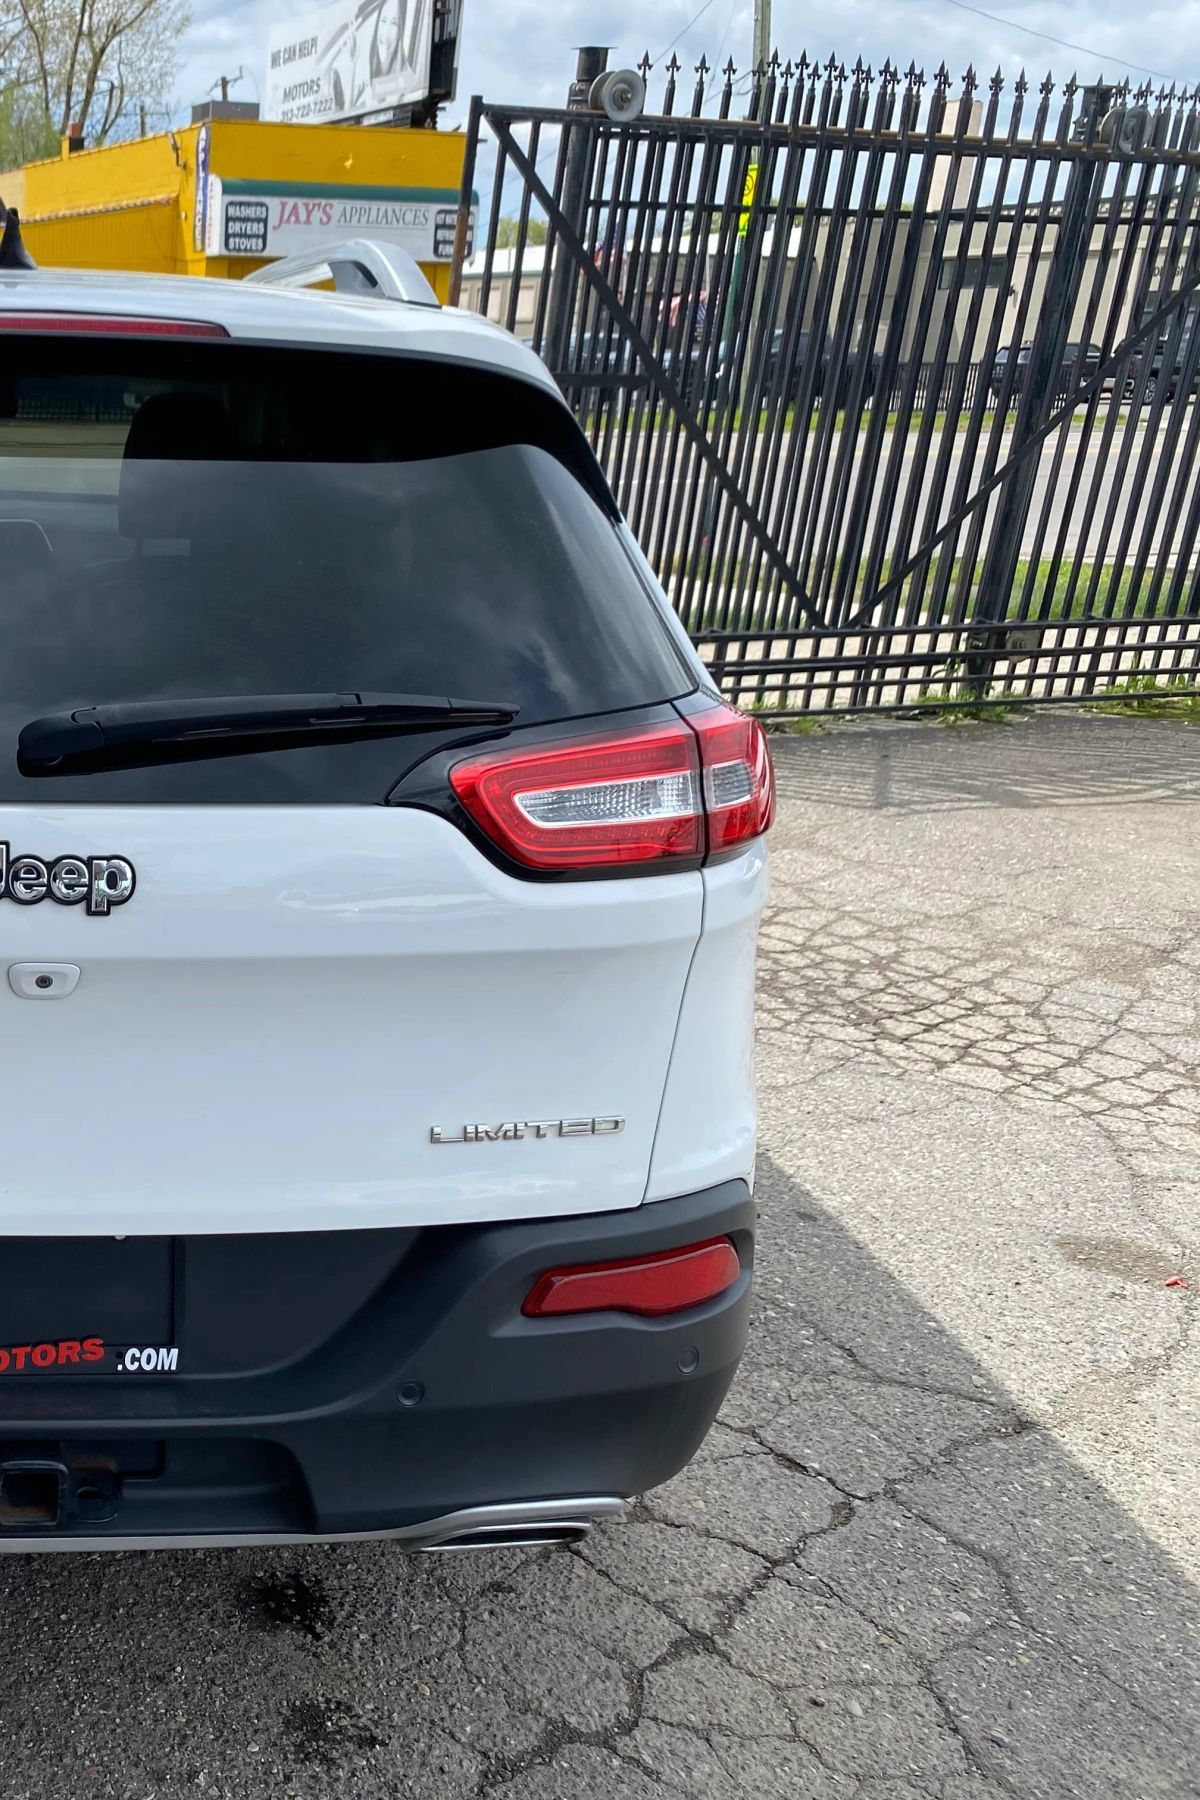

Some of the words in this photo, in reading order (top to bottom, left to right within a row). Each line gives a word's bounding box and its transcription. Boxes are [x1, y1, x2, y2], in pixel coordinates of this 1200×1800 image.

[271, 50, 282, 69] WE
[283, 44, 297, 65] CAN
[283, 77, 321, 104] MOTORS
[227, 205, 267, 219] WASHERS
[273, 200, 334, 231] JAY'S
[337, 205, 430, 227] APPLIANCES
[228, 221, 265, 235] DRYERS
[228, 236, 263, 250] STOVES
[430, 1114, 626, 1144] LIMITED
[117, 1347, 179, 1372] .COM
